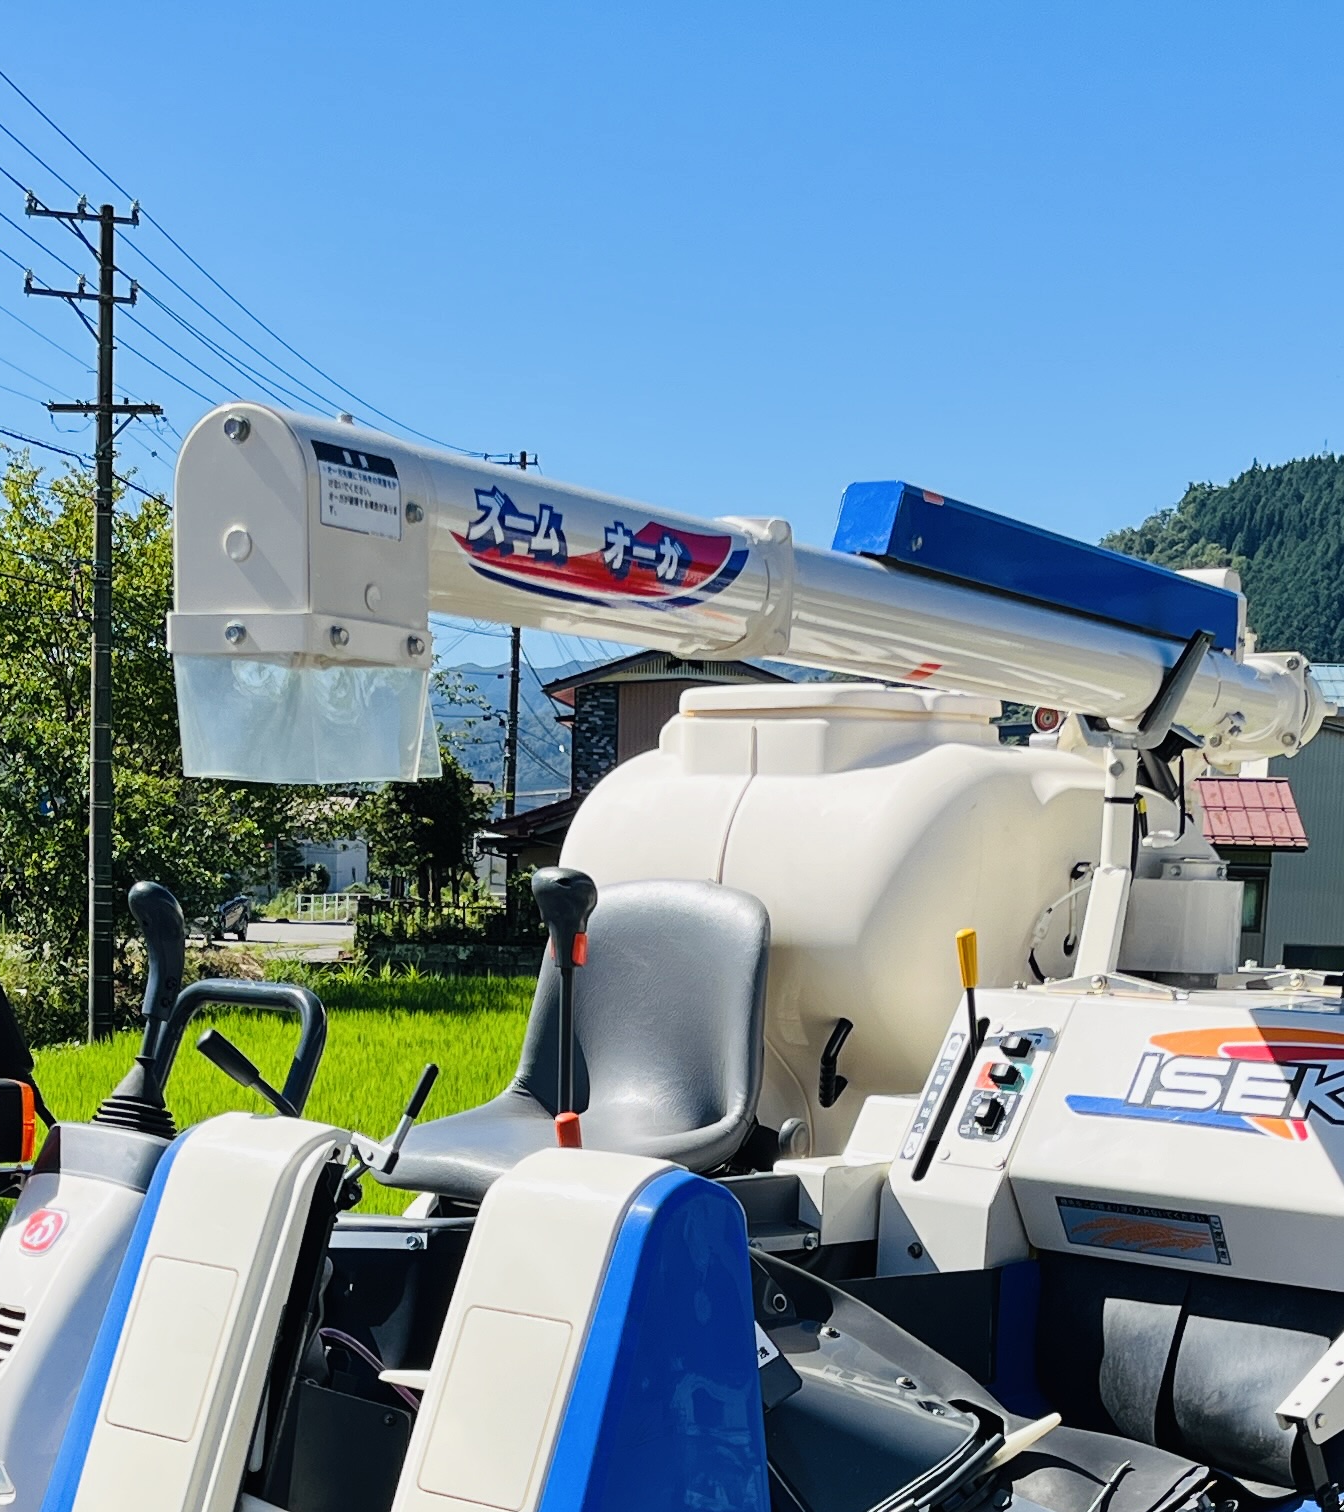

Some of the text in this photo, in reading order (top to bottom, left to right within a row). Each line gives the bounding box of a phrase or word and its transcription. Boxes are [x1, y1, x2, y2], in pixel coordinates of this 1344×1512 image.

[467, 487, 686, 581] ズーム オーガ
